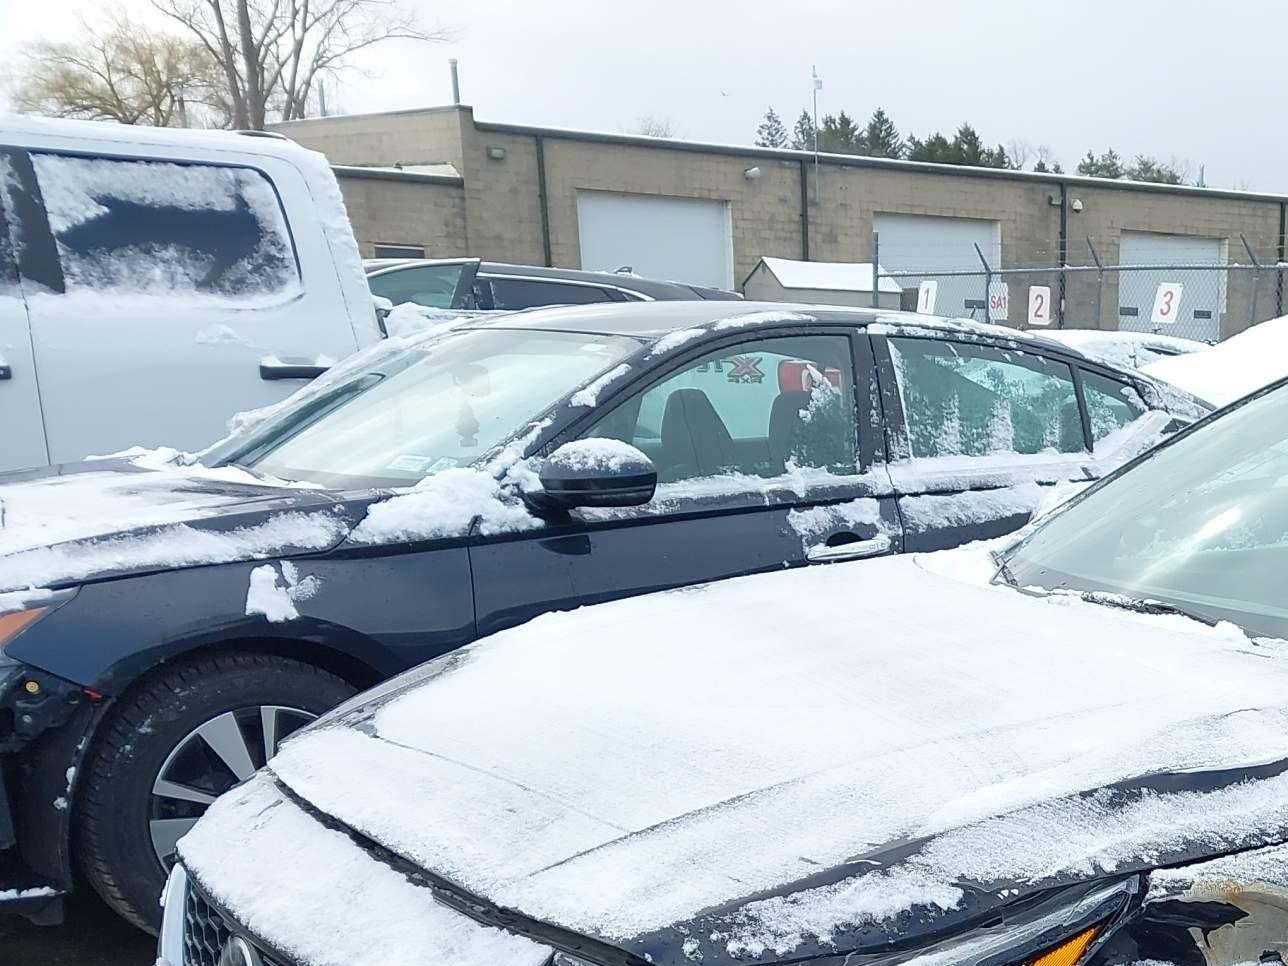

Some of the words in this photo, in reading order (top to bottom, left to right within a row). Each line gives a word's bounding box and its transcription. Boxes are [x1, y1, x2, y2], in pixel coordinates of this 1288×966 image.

[923, 286, 930, 310] 1
[1034, 294, 1044, 318] 2
[1159, 290, 1174, 316] 3
